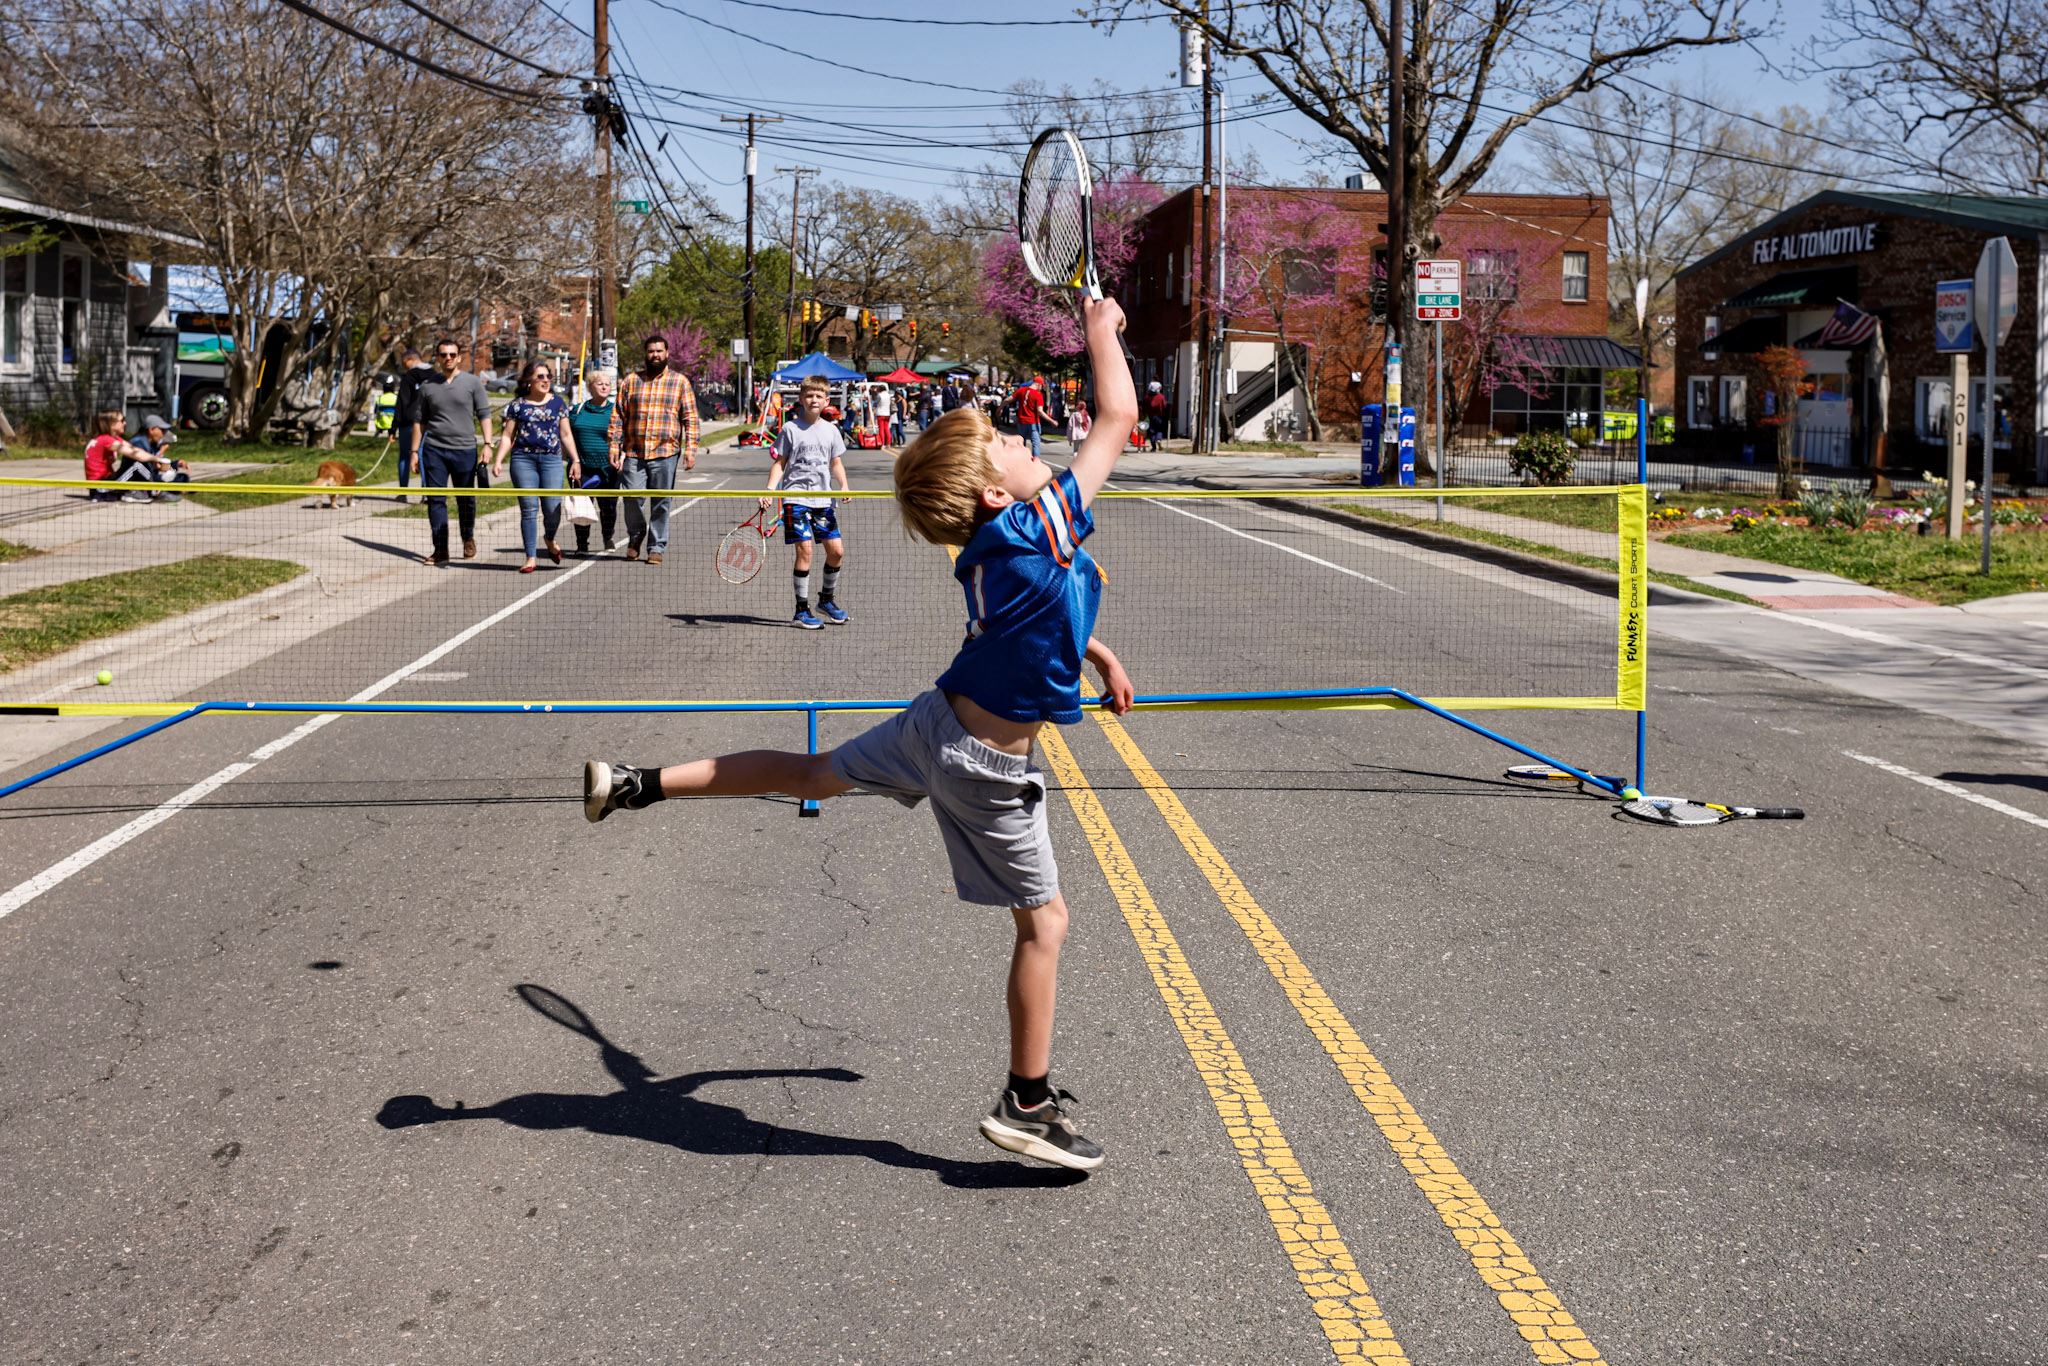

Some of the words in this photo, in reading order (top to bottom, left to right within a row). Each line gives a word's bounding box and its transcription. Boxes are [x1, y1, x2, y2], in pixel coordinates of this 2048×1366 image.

[1752, 237, 1779, 264] F&F
[1779, 223, 1877, 261] AUTOMOTIVE
[1418, 264, 1431, 276] NO
[1431, 266, 1457, 275] PARKING
[1425, 295, 1437, 305] BIKE
[1438, 295, 1453, 305] LANE
[1936, 293, 1967, 307] BOSCH
[1424, 308, 1436, 318] TOW
[1936, 310, 1966, 322] Service
[1954, 393, 1967, 446] 201
